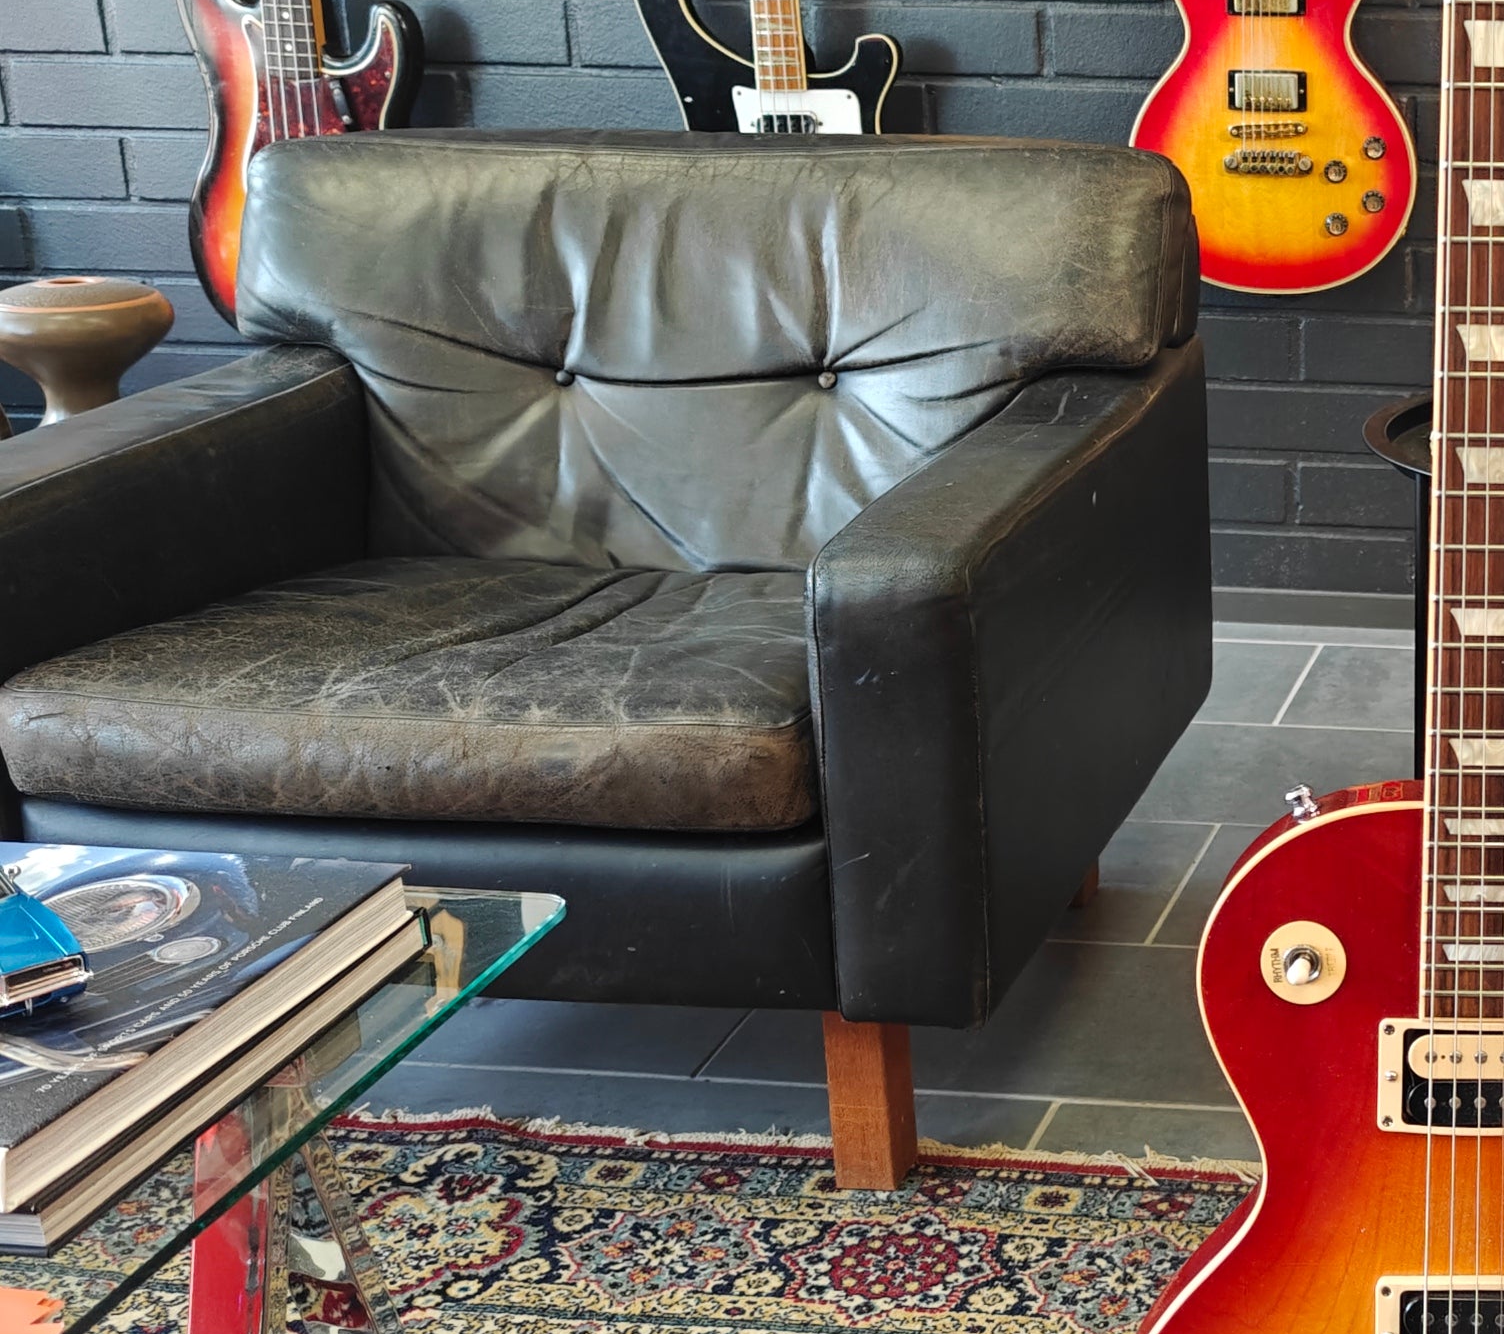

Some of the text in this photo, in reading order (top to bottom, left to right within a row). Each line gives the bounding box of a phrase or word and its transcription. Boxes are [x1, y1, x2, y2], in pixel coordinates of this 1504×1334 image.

[35, 1083, 53, 1094] 70
[133, 1011, 161, 1028] CARS
[158, 997, 180, 1011] AND
[177, 988, 194, 998] 50
[190, 969, 222, 989] YEARS
[218, 960, 232, 971] OF
[231, 934, 272, 962] PORSCHE
[267, 919, 293, 936] CLUB
[287, 897, 324, 921] FINLAND
[1270, 947, 1284, 984] RHYTHM
